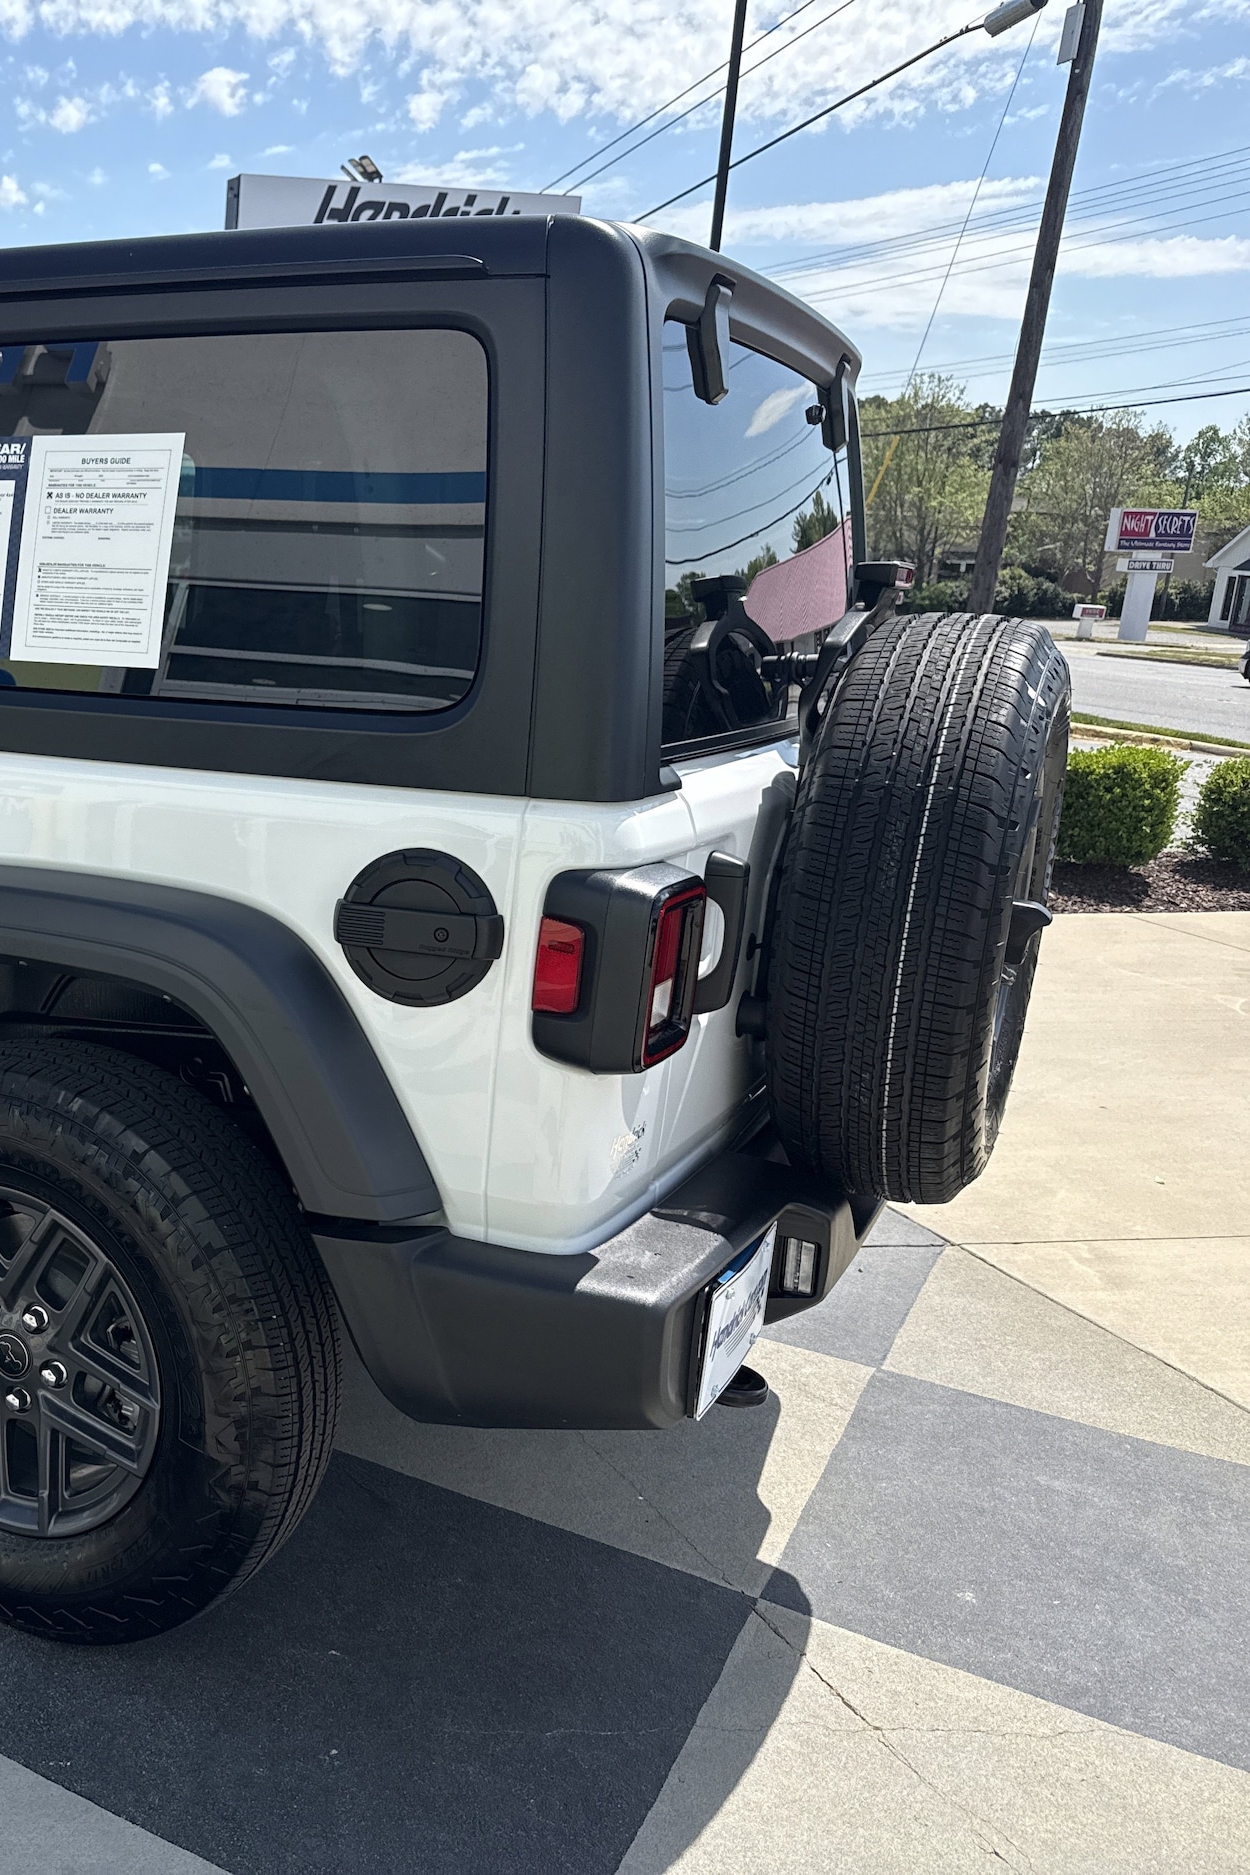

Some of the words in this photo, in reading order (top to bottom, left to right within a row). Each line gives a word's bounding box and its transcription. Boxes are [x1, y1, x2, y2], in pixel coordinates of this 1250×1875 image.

[313, 185, 521, 224] Hendri
[8, 455, 25, 463] MILE
[81, 457, 109, 465] BUYERS
[1157, 515, 1195, 535] SECRETS
[1129, 561, 1151, 569] DRIVE
[1152, 561, 1172, 570] THRU
